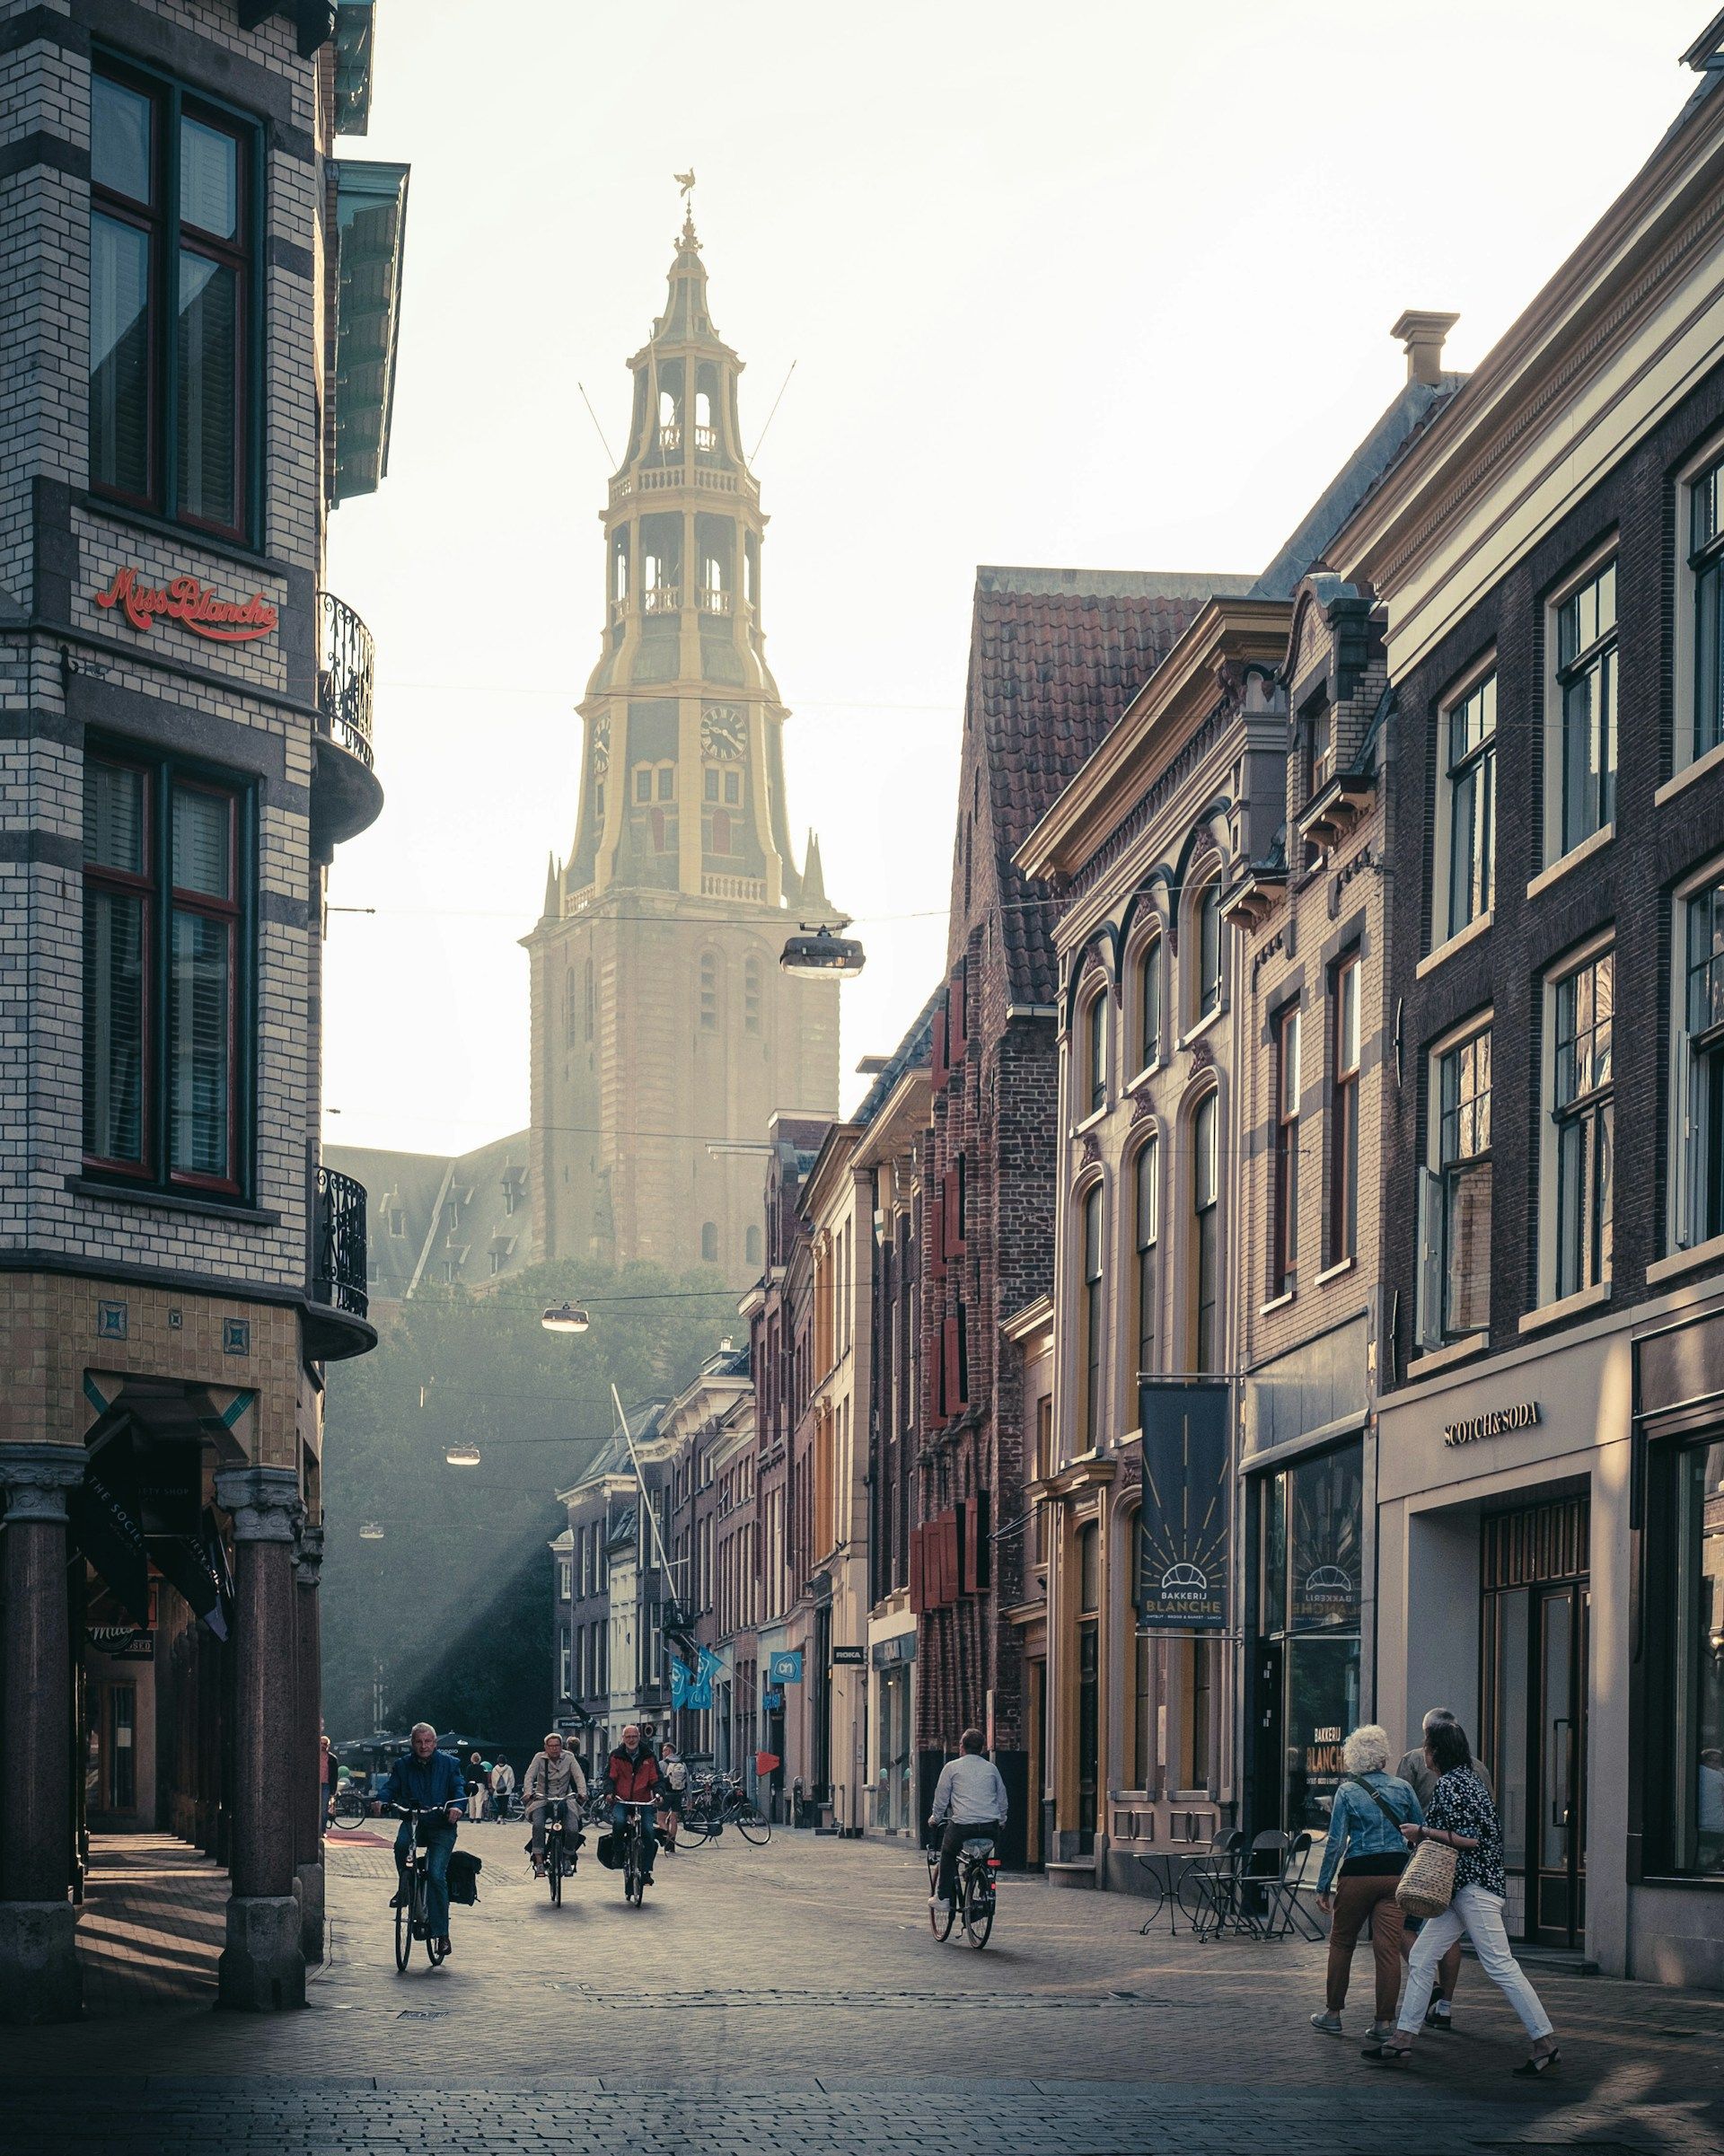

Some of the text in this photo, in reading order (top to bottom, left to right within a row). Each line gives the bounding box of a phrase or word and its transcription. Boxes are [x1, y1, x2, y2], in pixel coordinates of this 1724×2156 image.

[94, 567, 278, 642] Miss Blanche
[1444, 1402, 1538, 1447] SCOTCH&SODA
[86, 1474, 111, 1501] THE
[1146, 1600, 1222, 1613] BLANCHE
[1161, 1592, 1207, 1600] BAKKERIJ
[1315, 1727, 1341, 1743] BAKKERIJ
